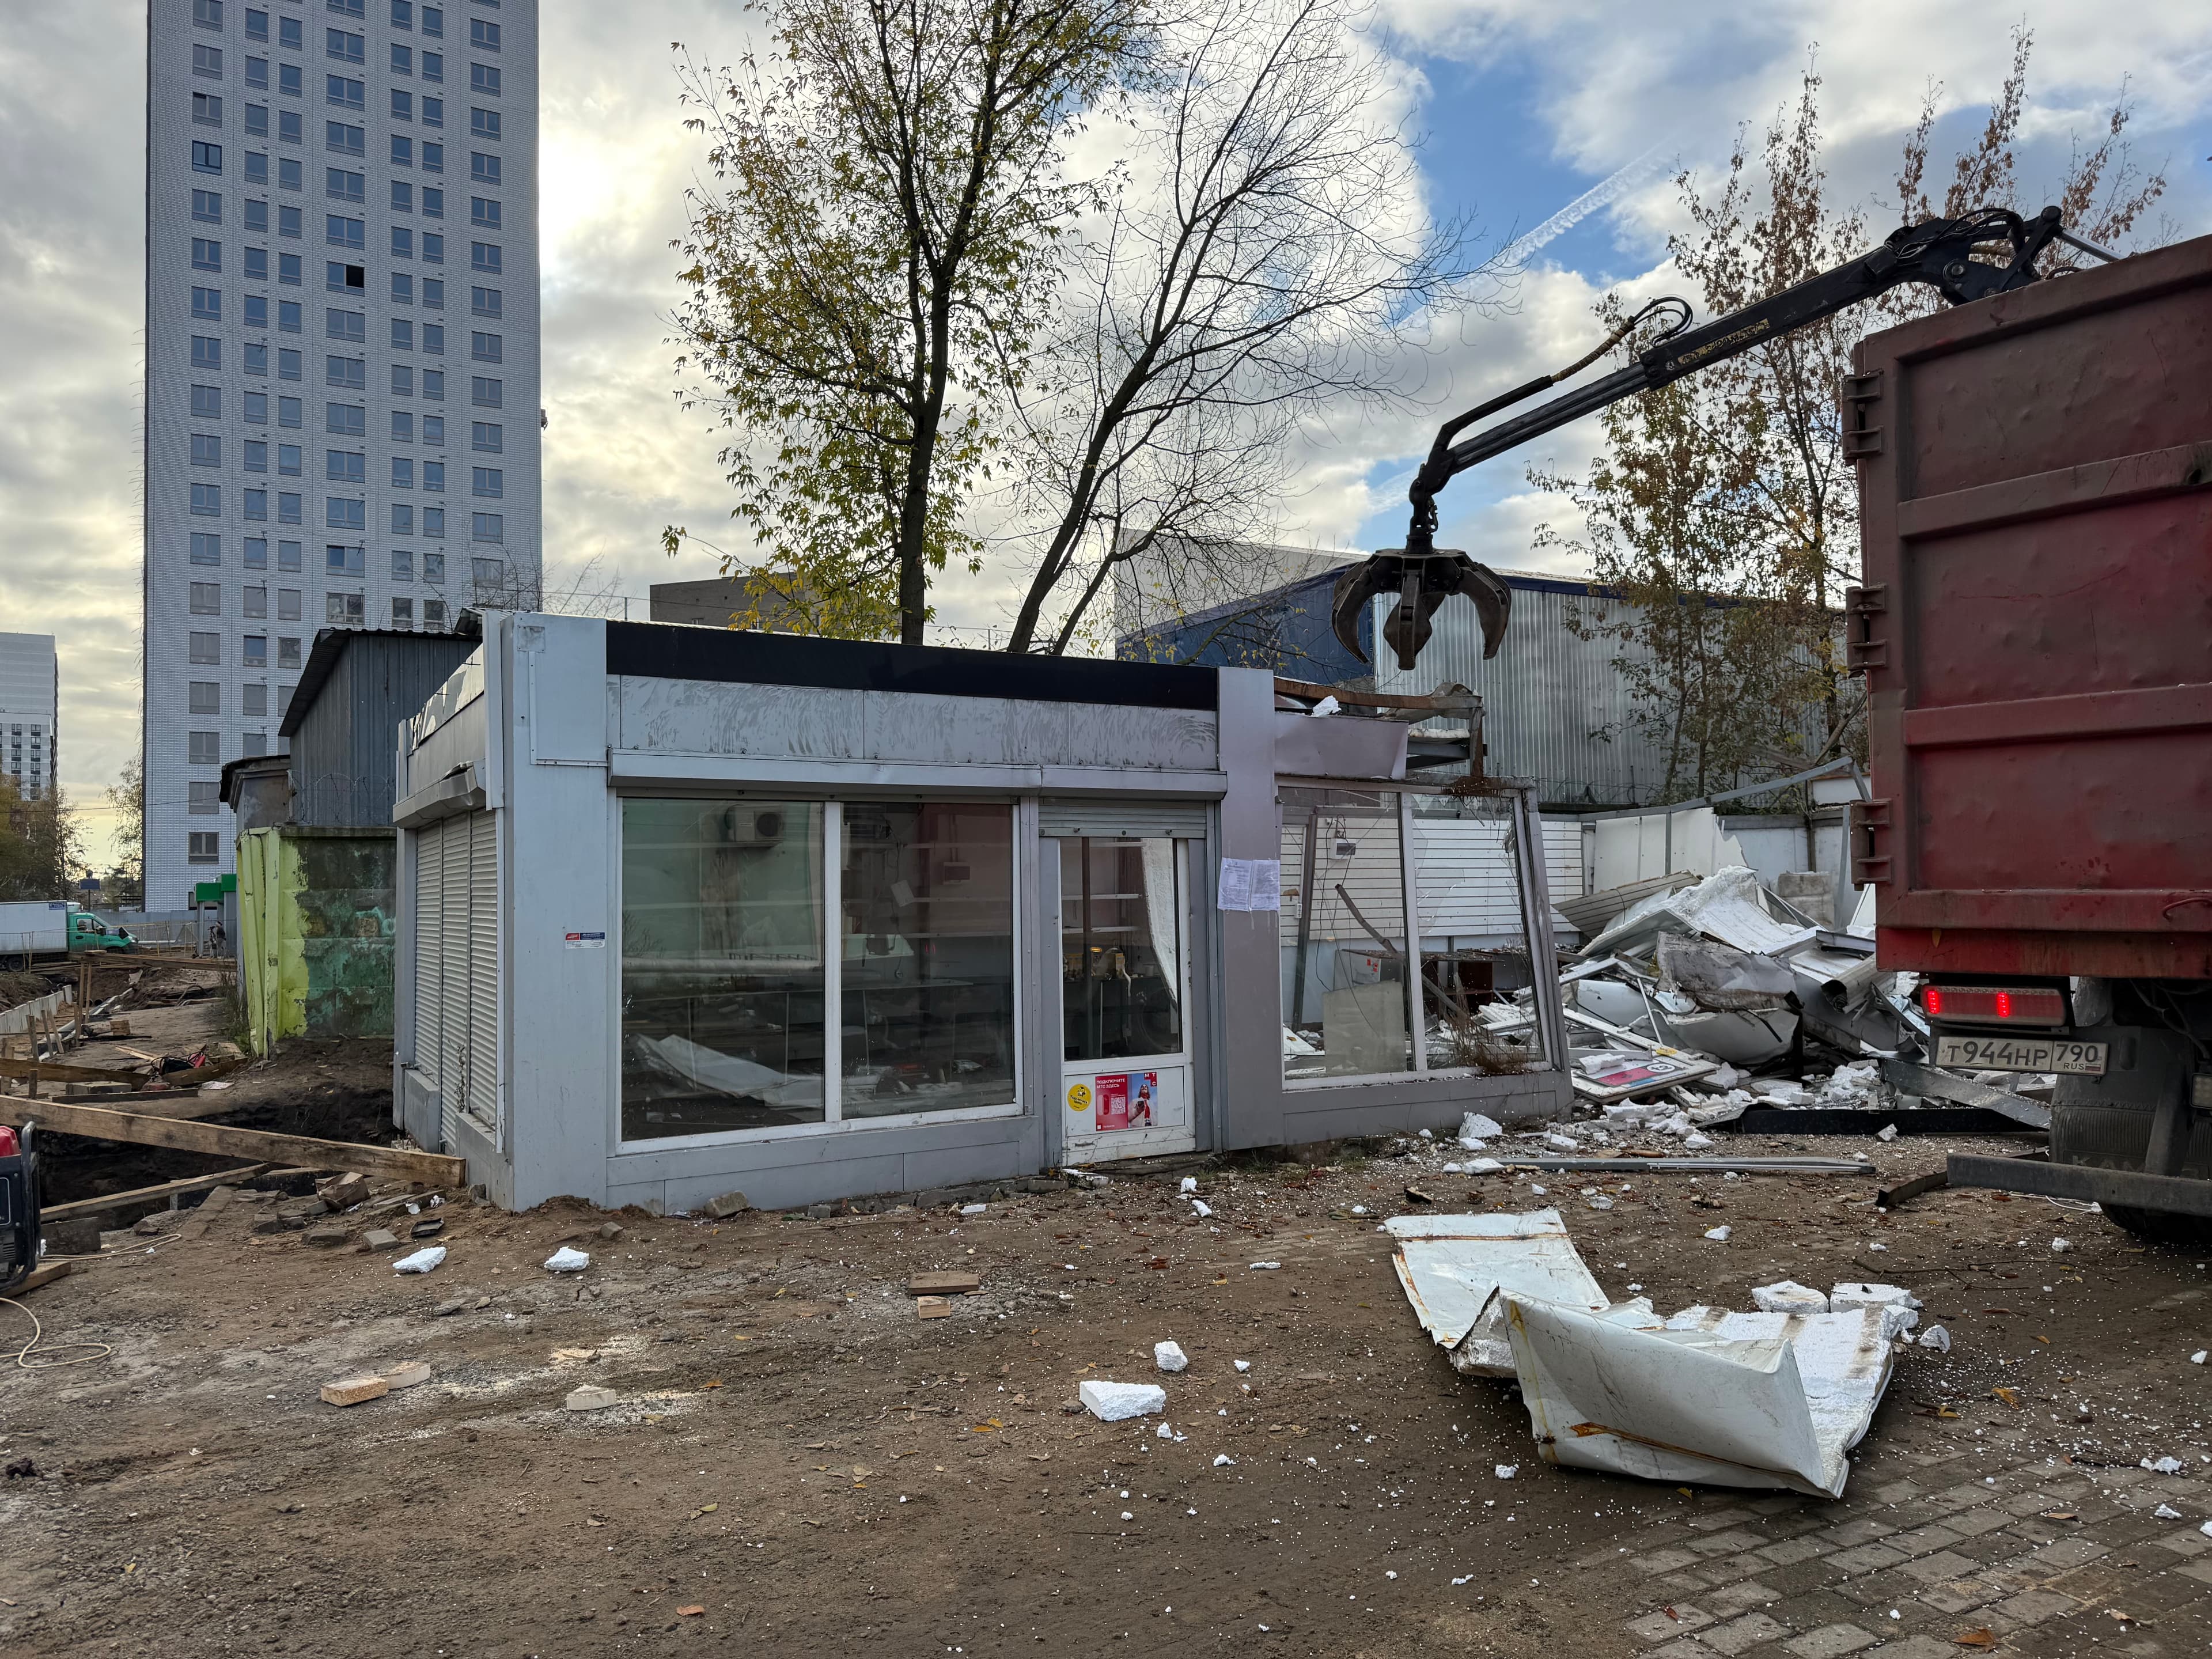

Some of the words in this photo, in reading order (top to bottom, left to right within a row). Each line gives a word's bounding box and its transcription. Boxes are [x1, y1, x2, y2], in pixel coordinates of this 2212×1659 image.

[1947, 1040, 2048, 1066] Т944НР
[2056, 1043, 2099, 1063] 790
[2063, 1062, 2085, 1070] RUS
